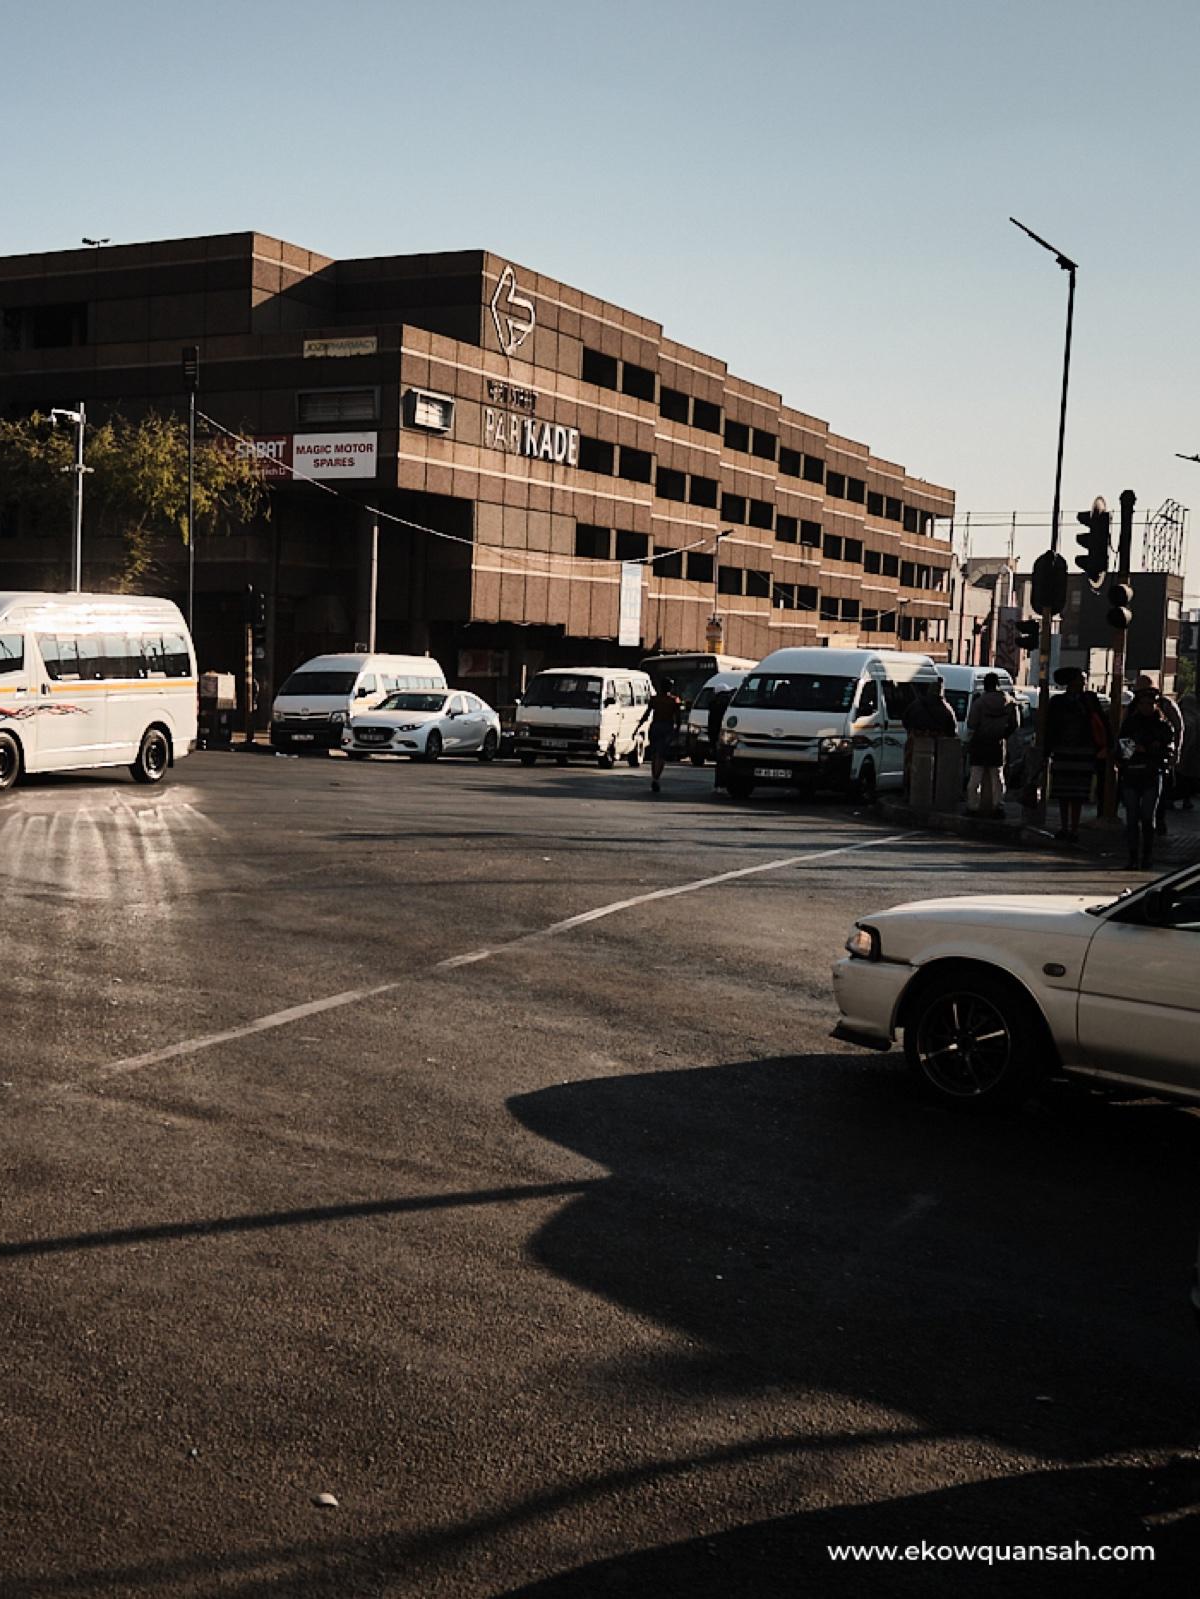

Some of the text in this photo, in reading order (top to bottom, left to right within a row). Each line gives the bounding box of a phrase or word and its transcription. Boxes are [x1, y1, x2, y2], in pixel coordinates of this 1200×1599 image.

[485, 407, 579, 465] PARKADE
[296, 443, 374, 455] MAGIC MOTOR
[313, 457, 356, 469] SPARES
